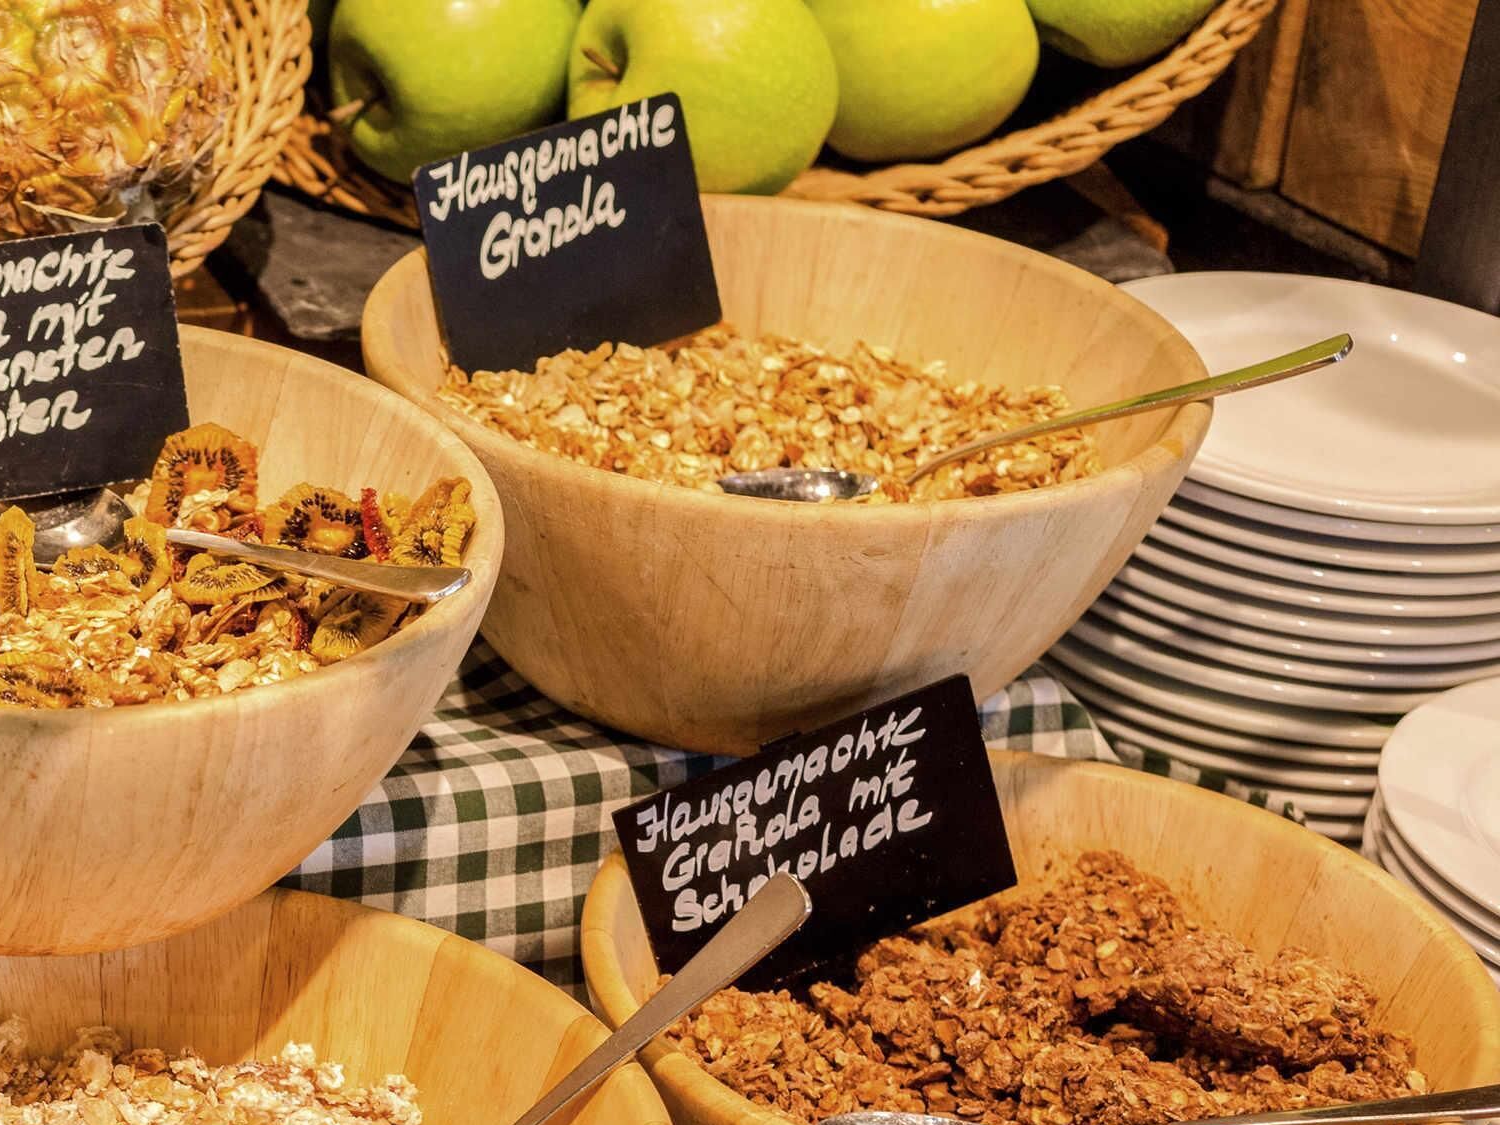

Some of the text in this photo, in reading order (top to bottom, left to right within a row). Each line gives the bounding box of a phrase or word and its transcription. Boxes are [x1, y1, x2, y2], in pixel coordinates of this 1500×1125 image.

[428, 98, 676, 222] Hausgemachte
[480, 174, 626, 280] Granola
[27, 279, 117, 343] mit
[636, 706, 926, 852] Hausgemachte
[662, 748, 917, 891] Granola mit
